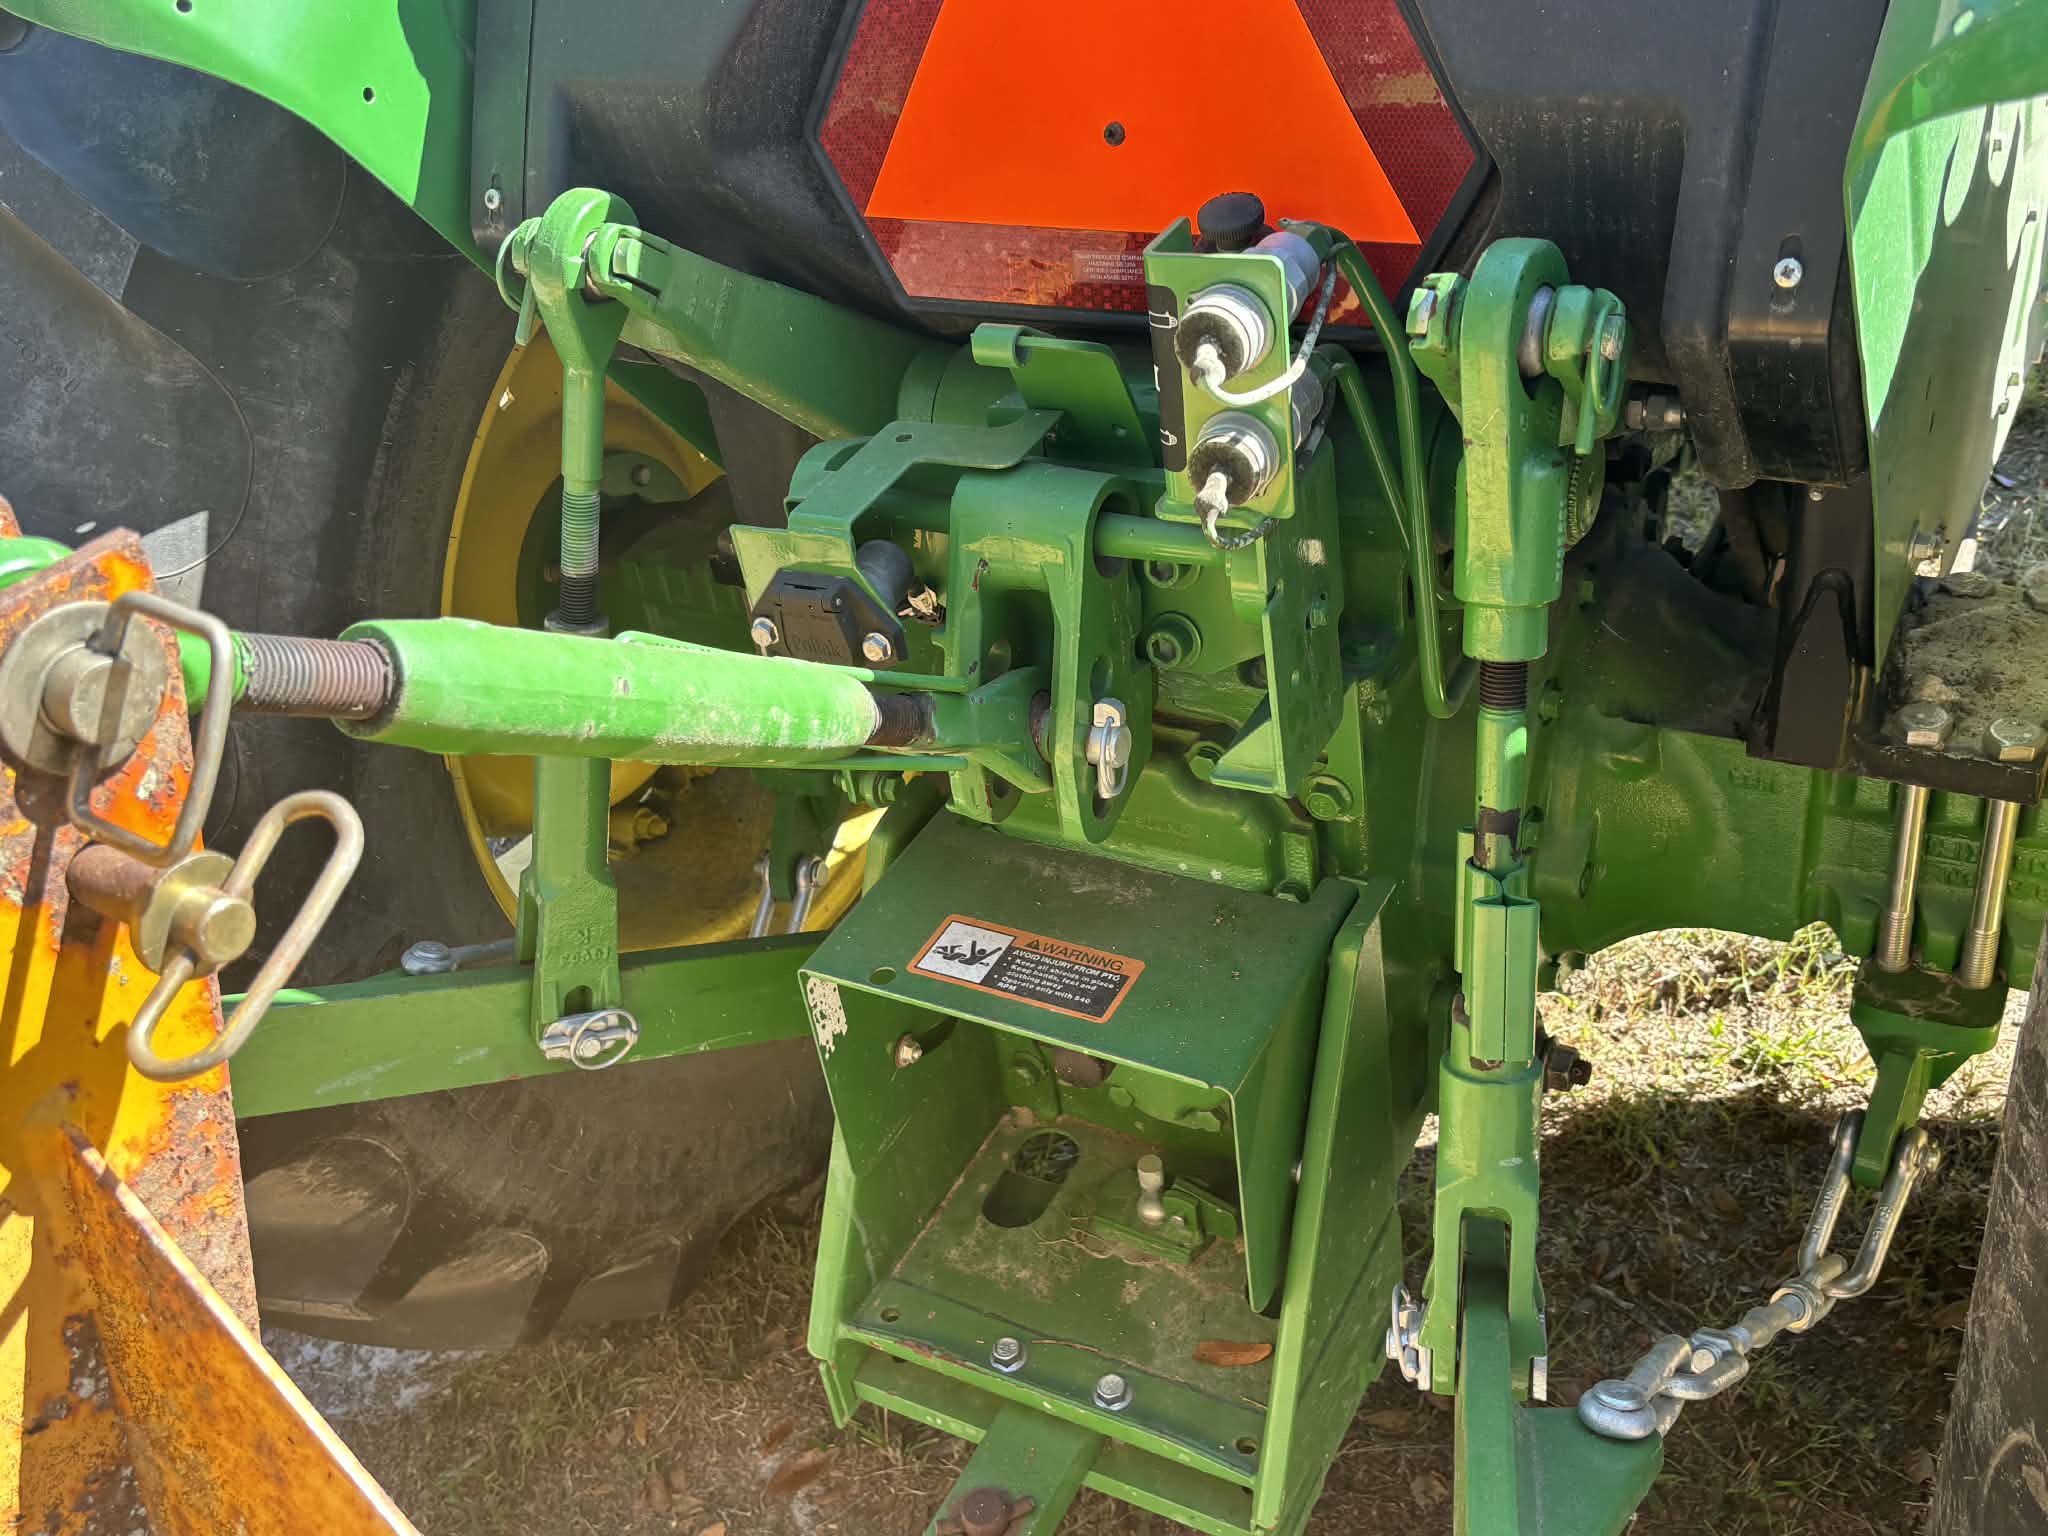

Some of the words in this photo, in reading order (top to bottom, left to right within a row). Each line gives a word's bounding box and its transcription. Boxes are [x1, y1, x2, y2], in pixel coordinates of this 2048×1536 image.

[1013, 949, 1040, 960] AVOID
[1041, 956, 1073, 969] INJURY
[1073, 964, 1100, 976] FROM
[1043, 942, 1124, 970] WARNING
[997, 982, 1017, 991] RPM
[1010, 964, 1032, 974] Keep
[1080, 983, 1097, 991] and
[1015, 958, 1036, 967] Keep
[1090, 979, 1114, 989] place
[1041, 981, 1063, 990] away
[1002, 976, 1034, 989] Operate
[1036, 985, 1053, 995] only
[1054, 991, 1073, 1000] with
